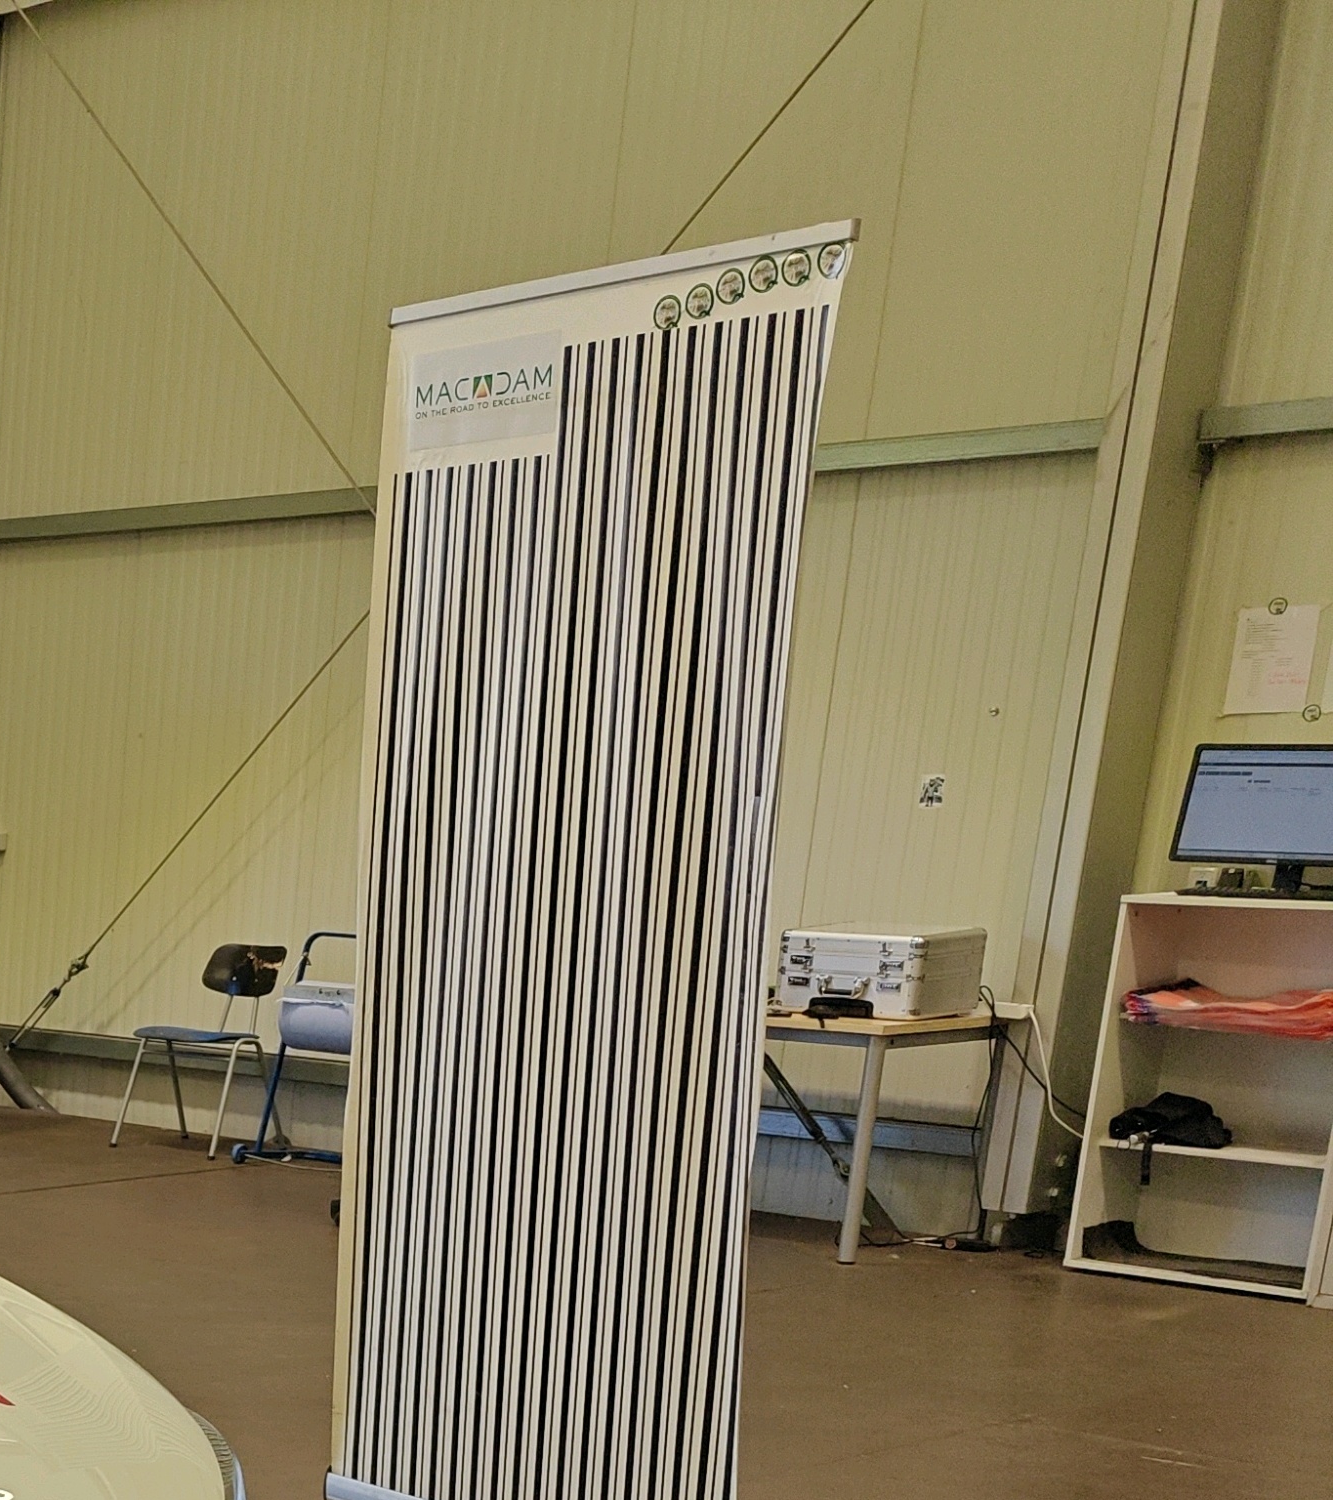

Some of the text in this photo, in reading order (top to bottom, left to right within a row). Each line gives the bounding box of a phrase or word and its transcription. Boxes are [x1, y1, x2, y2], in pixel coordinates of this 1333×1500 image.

[415, 363, 553, 408] MACADAM
[415, 391, 552, 420] ON THE ROAD TO EXCELLENCE
